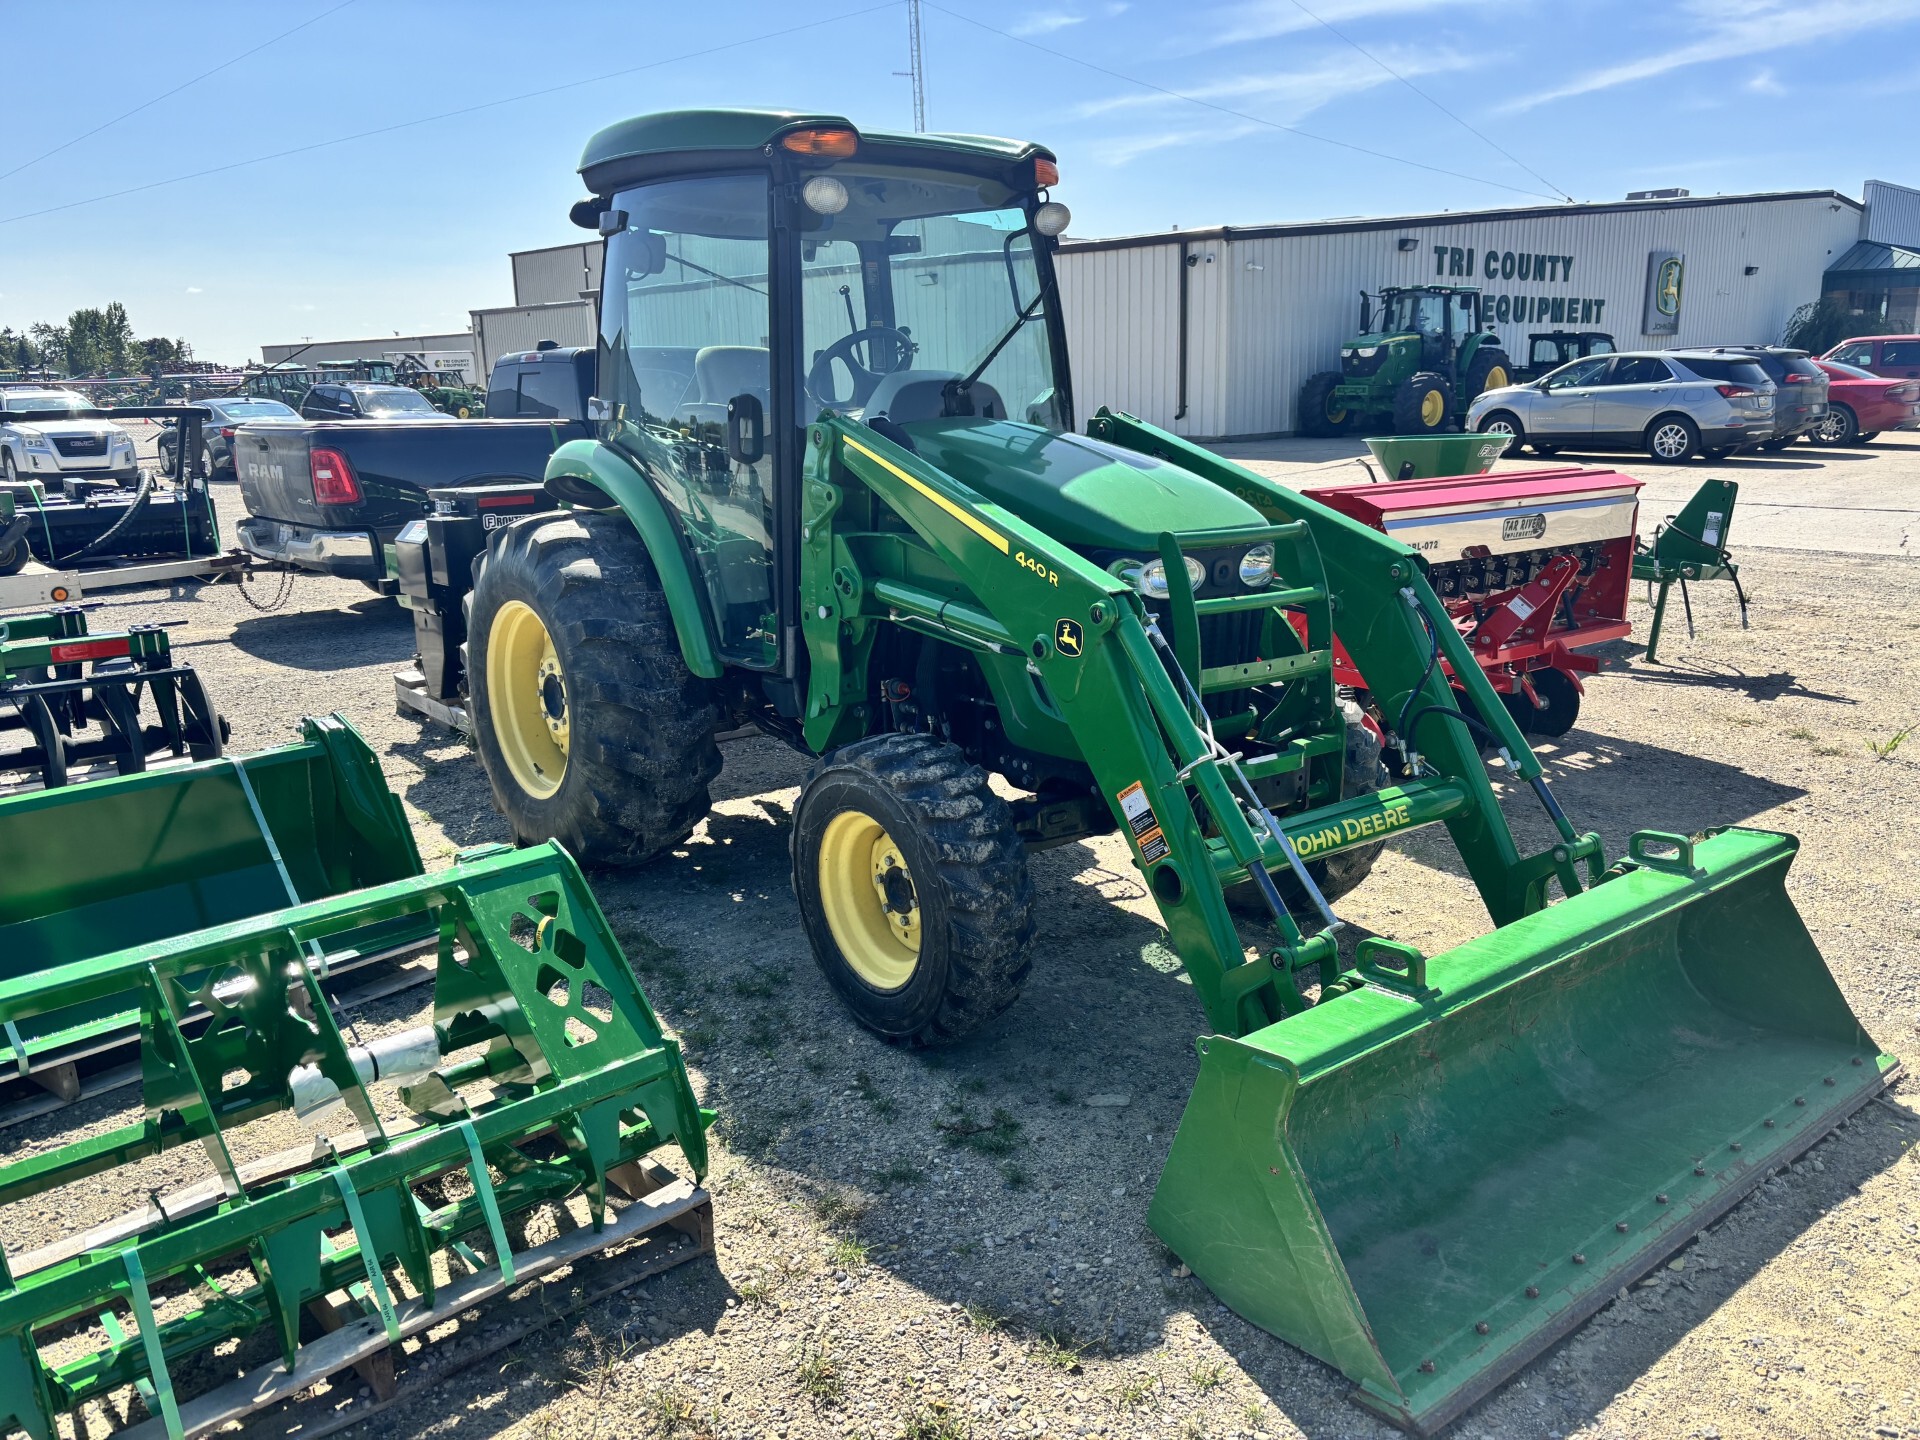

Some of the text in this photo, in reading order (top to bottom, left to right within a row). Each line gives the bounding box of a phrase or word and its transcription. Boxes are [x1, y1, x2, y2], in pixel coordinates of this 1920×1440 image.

[1434, 245, 1574, 282] TRI COUNTY
[1481, 294, 1606, 324] EQUIPMENT
[248, 463, 283, 479] RAM
[1505, 516, 1543, 531] TAR RIVER
[1015, 551, 1058, 587] 440 R
[1341, 805, 1410, 841] DEERE
